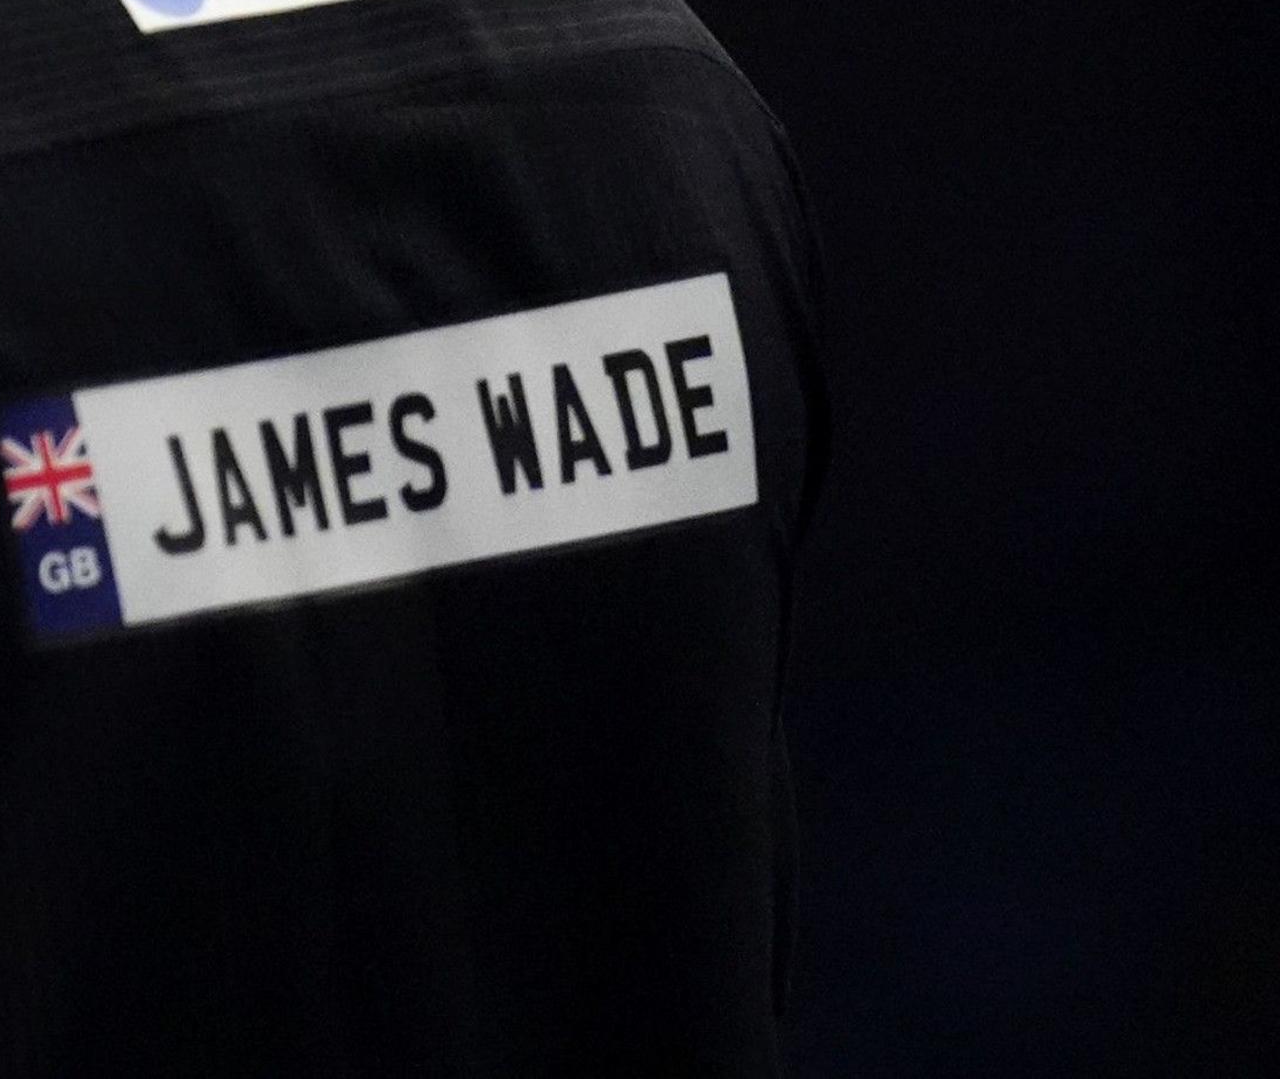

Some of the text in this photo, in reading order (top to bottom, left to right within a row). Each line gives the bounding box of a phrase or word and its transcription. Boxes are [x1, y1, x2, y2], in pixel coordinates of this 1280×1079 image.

[152, 334, 730, 556] JAMES WADE
[37, 548, 103, 594] GB
